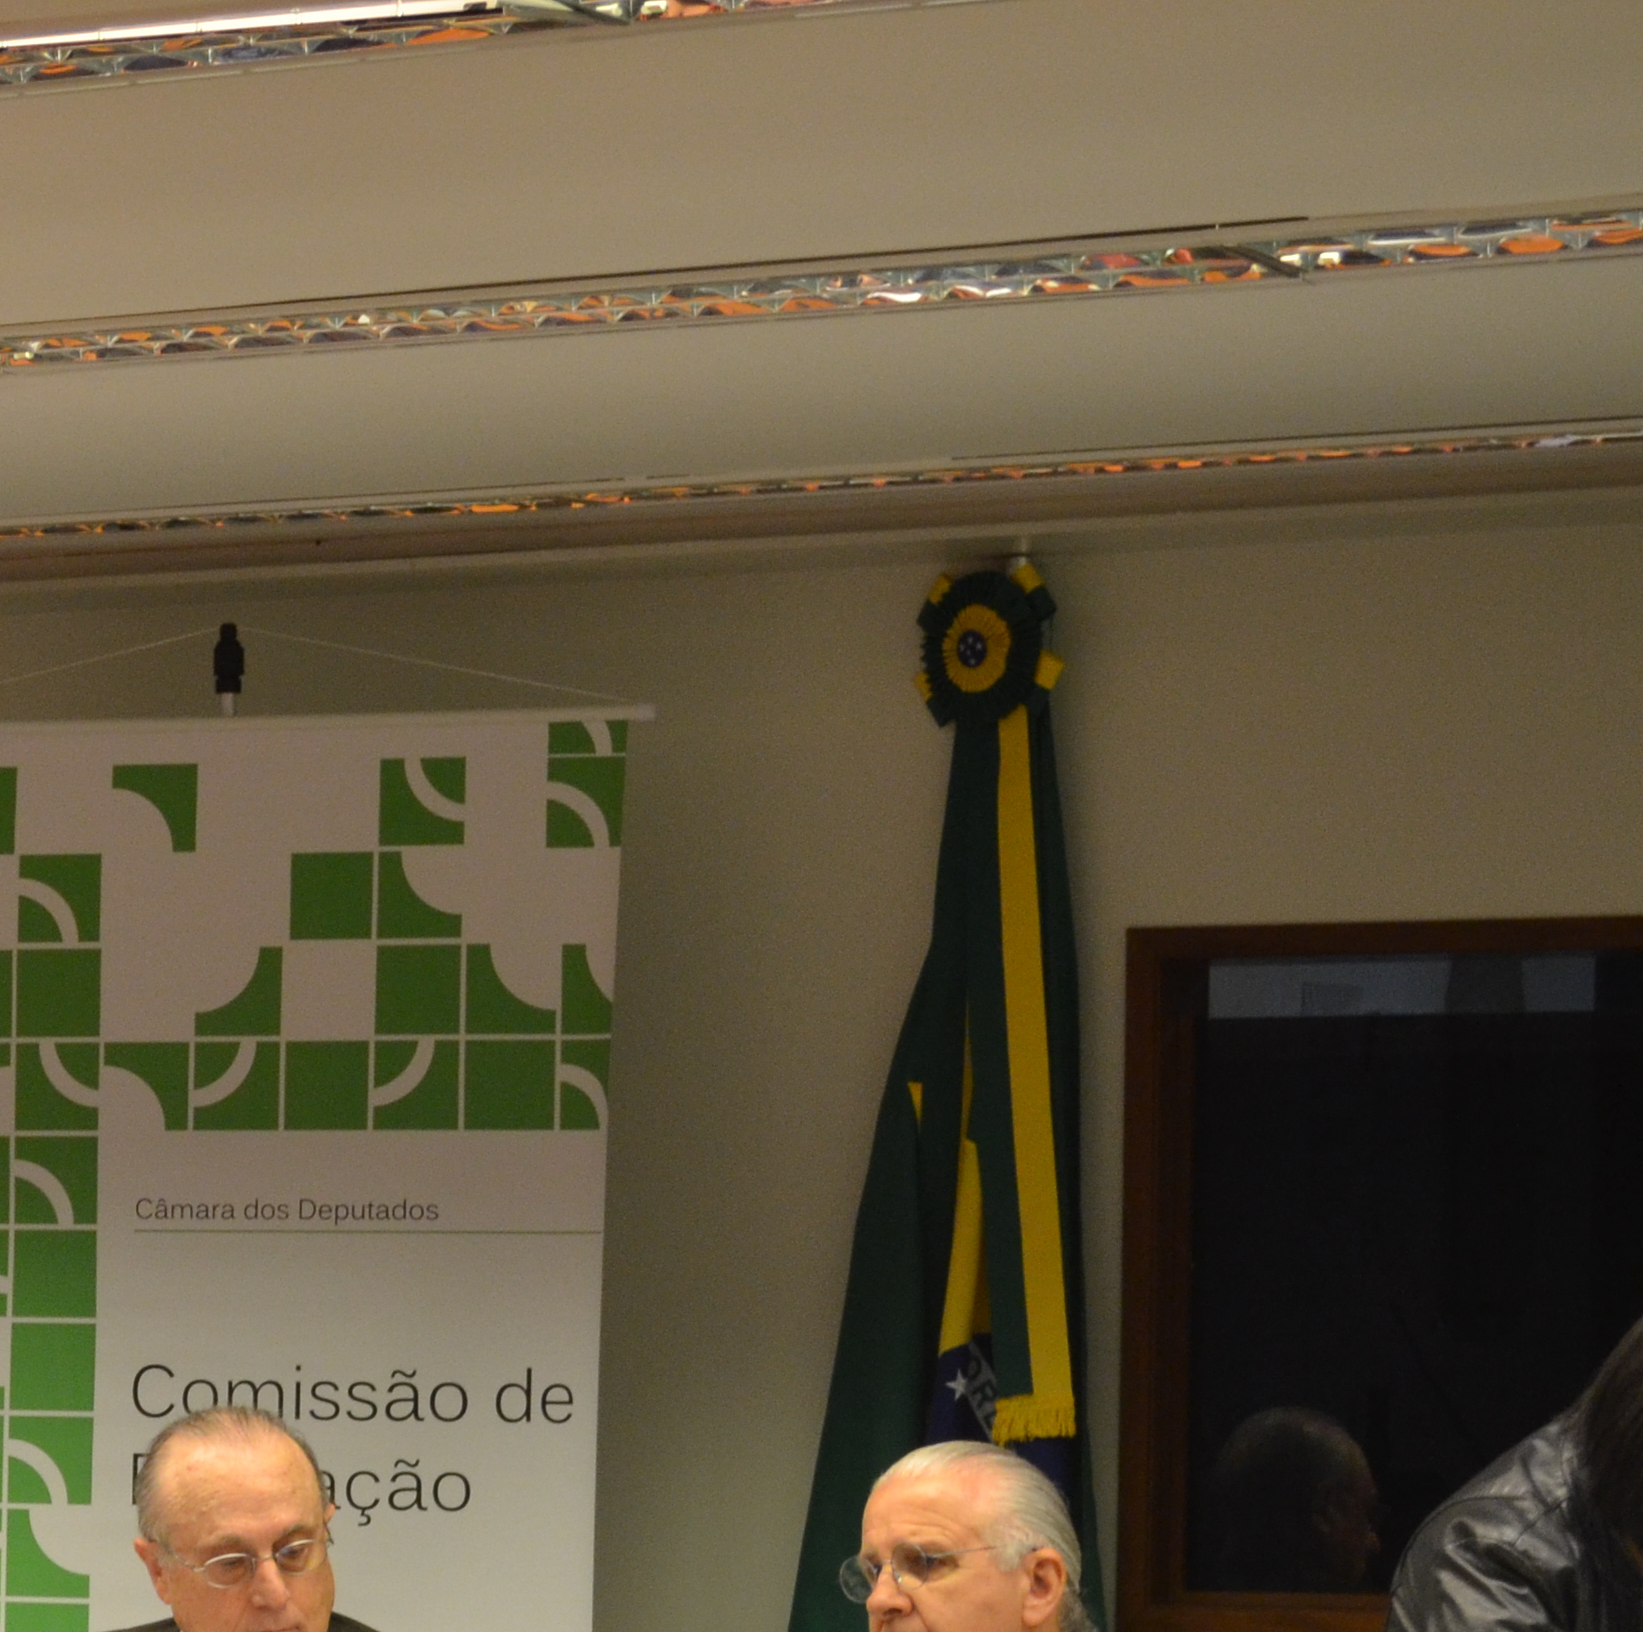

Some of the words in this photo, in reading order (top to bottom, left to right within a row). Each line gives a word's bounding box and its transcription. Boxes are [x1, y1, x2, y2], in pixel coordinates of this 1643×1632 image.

[135, 1197, 235, 1221] Câmara
[243, 1198, 290, 1221] dos
[298, 1198, 440, 1225] Deputados
[132, 1364, 469, 1423] Comissão
[495, 1367, 575, 1424] de
